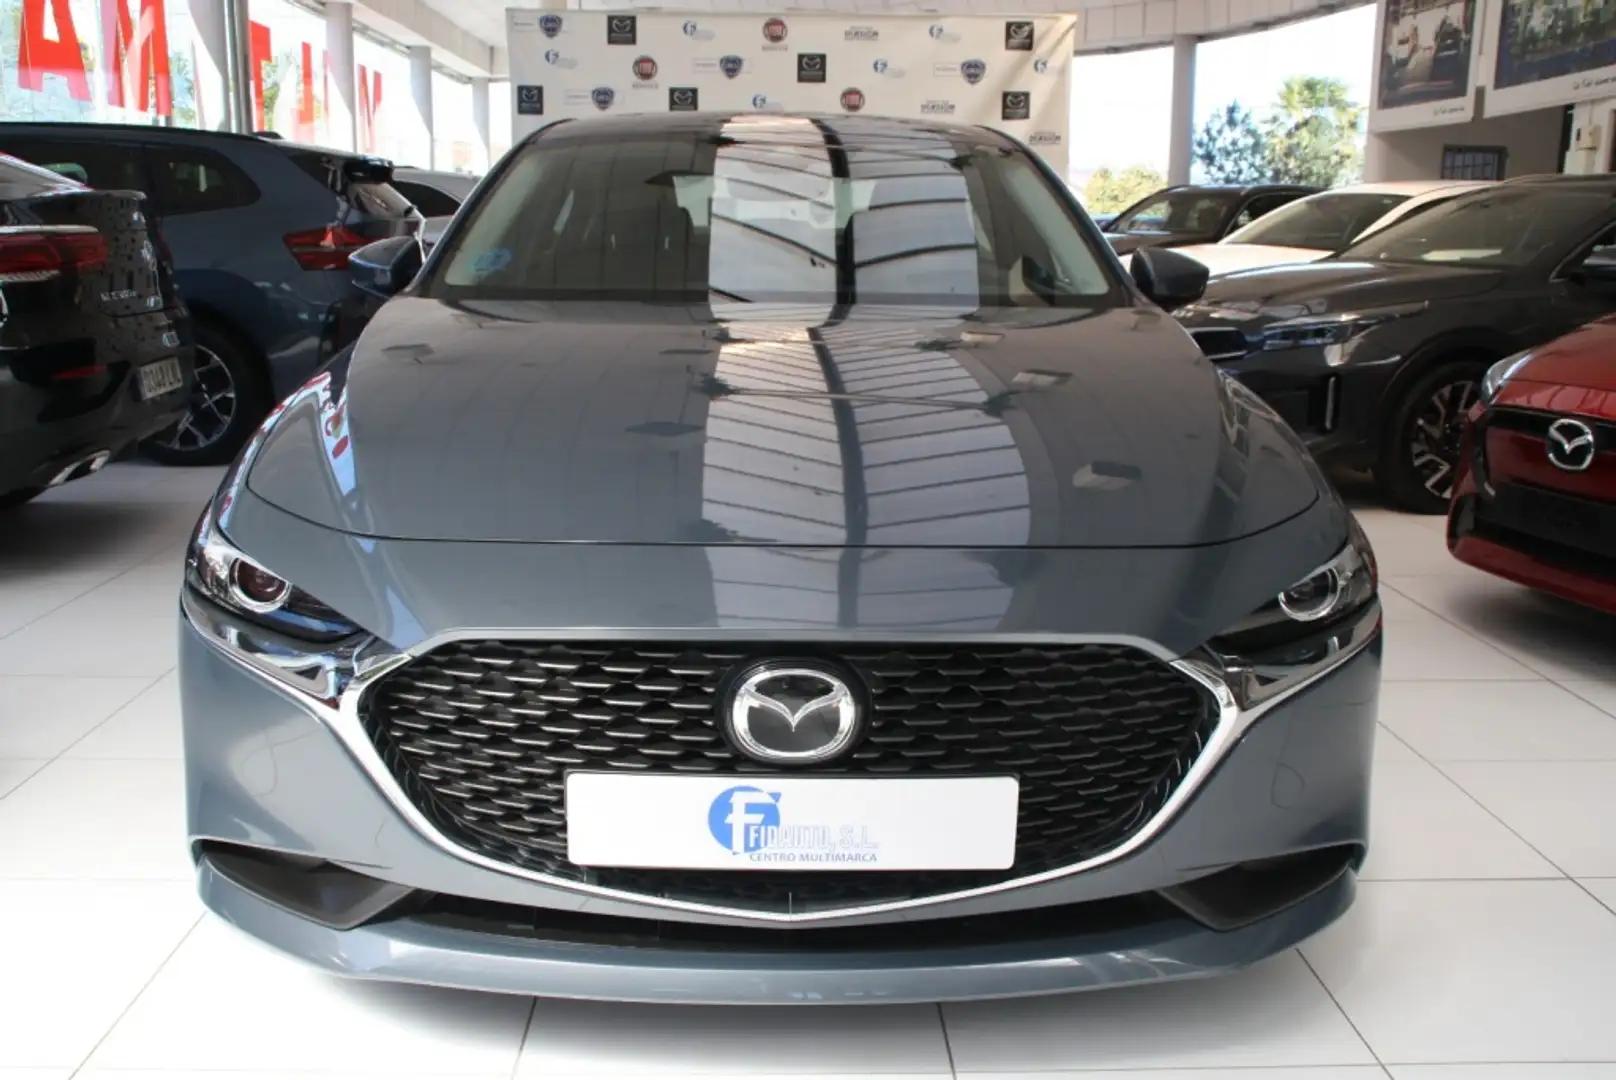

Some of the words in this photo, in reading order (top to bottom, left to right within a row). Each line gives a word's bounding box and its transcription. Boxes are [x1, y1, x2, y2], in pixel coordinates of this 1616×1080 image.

[839, 824, 878, 850] S.L.
[749, 852, 796, 863] CENTRO
[798, 852, 878, 863] MULTIMARCA
